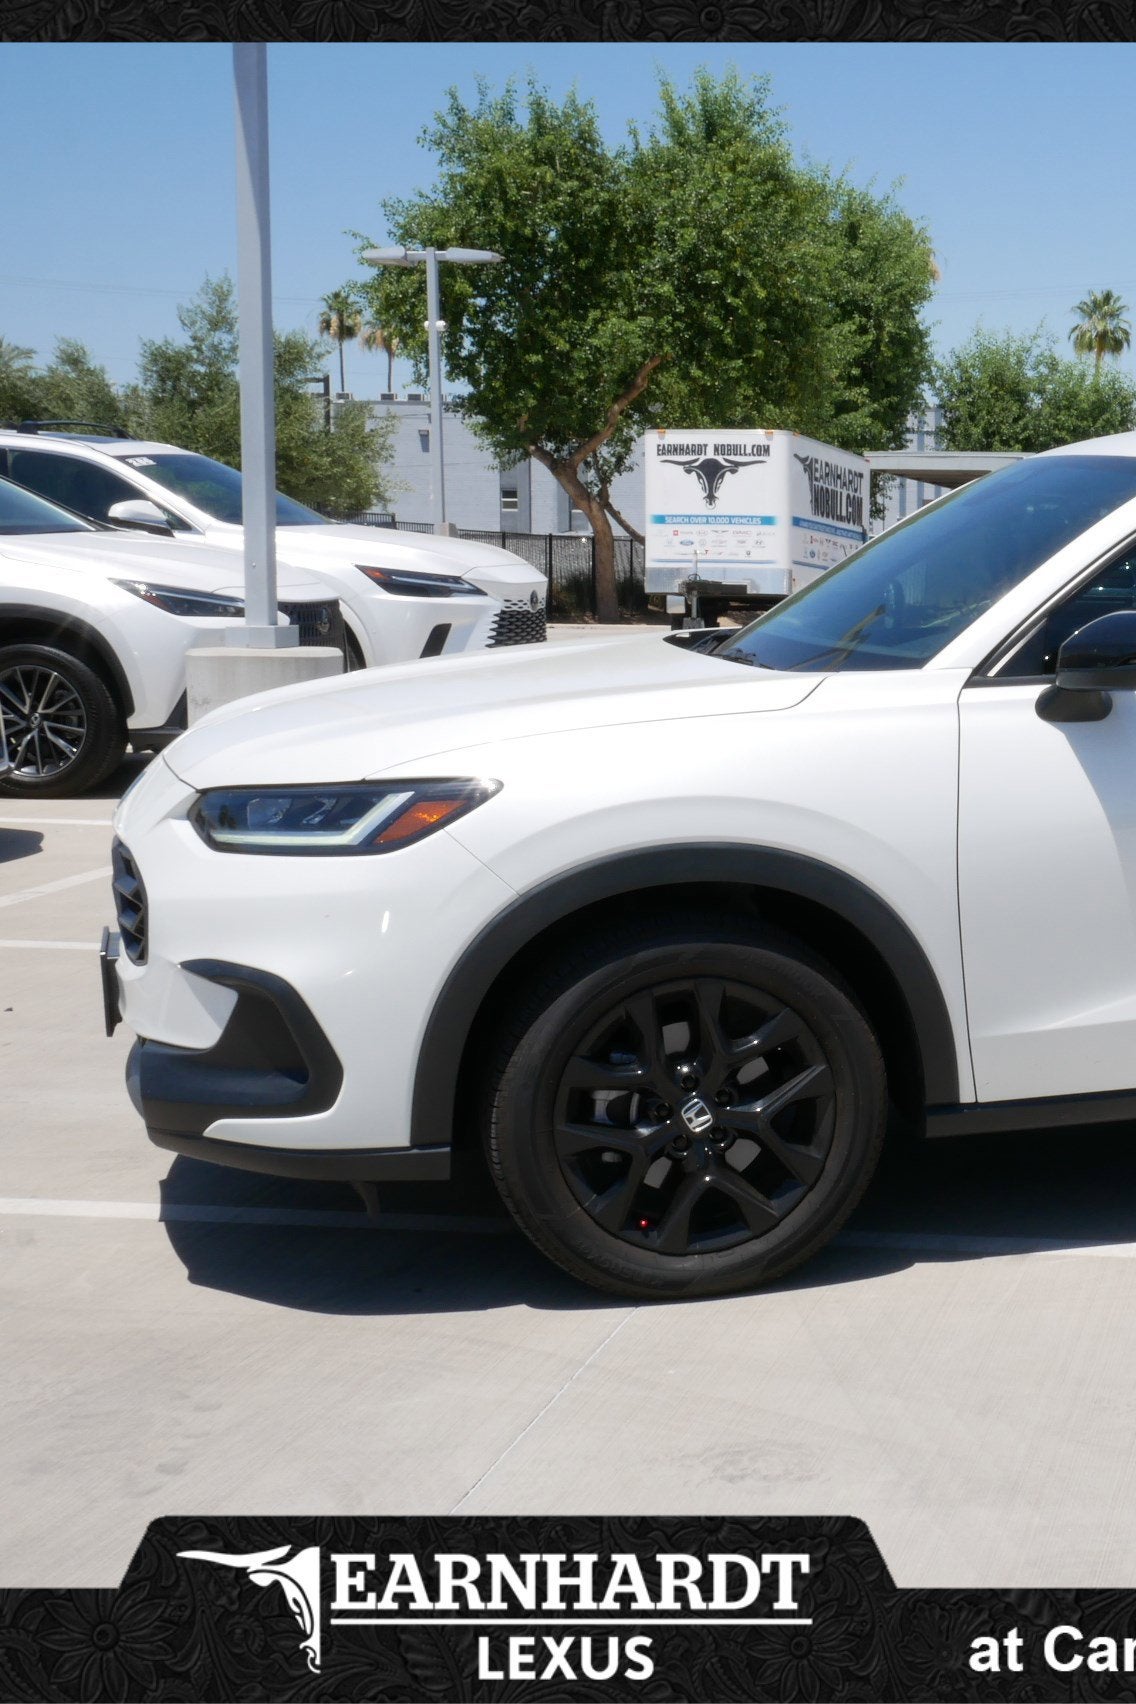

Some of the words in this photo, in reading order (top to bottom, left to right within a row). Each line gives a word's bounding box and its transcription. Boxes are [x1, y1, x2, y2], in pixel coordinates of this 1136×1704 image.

[656, 443, 708, 456] EARNHARDT
[713, 443, 771, 457] NOBULL.COM
[813, 457, 864, 496] EARNHARDT
[813, 483, 863, 527] NOBULL.COM
[664, 516, 689, 524] SEARCH
[690, 516, 708, 524] OVER
[731, 517, 762, 525] VEHICLES
